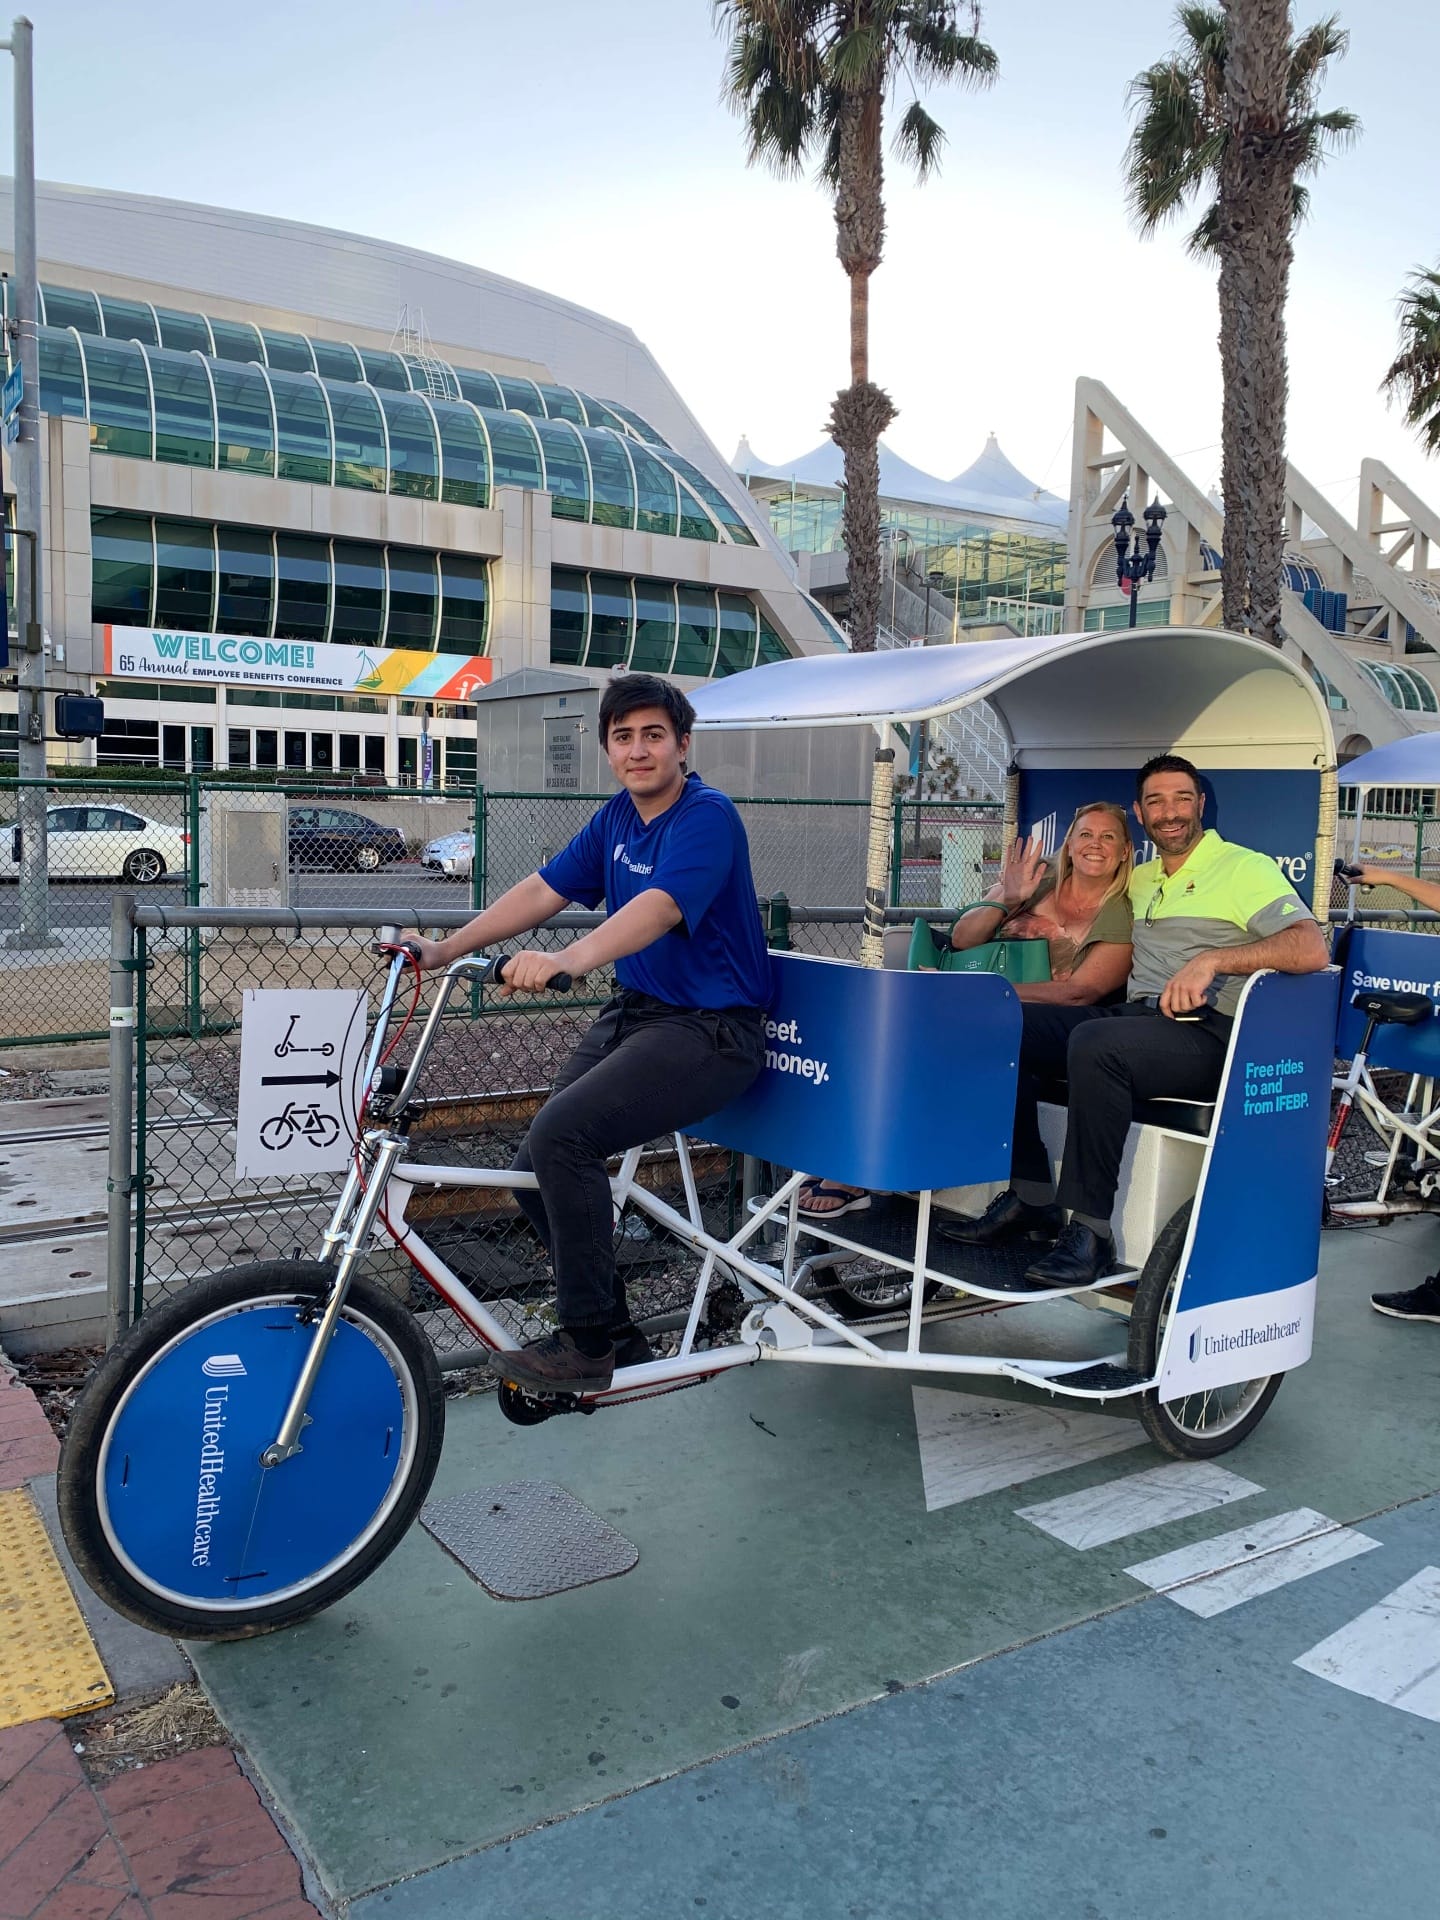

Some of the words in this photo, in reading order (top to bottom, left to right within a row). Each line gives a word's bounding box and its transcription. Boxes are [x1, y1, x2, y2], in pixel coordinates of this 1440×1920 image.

[152, 633, 315, 669] WELCOME!
[119, 655, 135, 672] 65
[138, 656, 189, 675] Annual
[192, 668, 241, 679] EMPLOYEE
[243, 671, 285, 683] BENEFITS
[287, 675, 344, 686] CONFERENCE
[1352, 970, 1391, 991] Save
[1393, 978, 1431, 996] your
[764, 1049, 829, 1085] money.
[1245, 1062, 1274, 1079] Free
[1276, 1058, 1304, 1076] rides
[1244, 1081, 1258, 1097] to
[1260, 1077, 1283, 1096] and
[1244, 1099, 1274, 1116] from
[1276, 1092, 1309, 1112] IFEBP.
